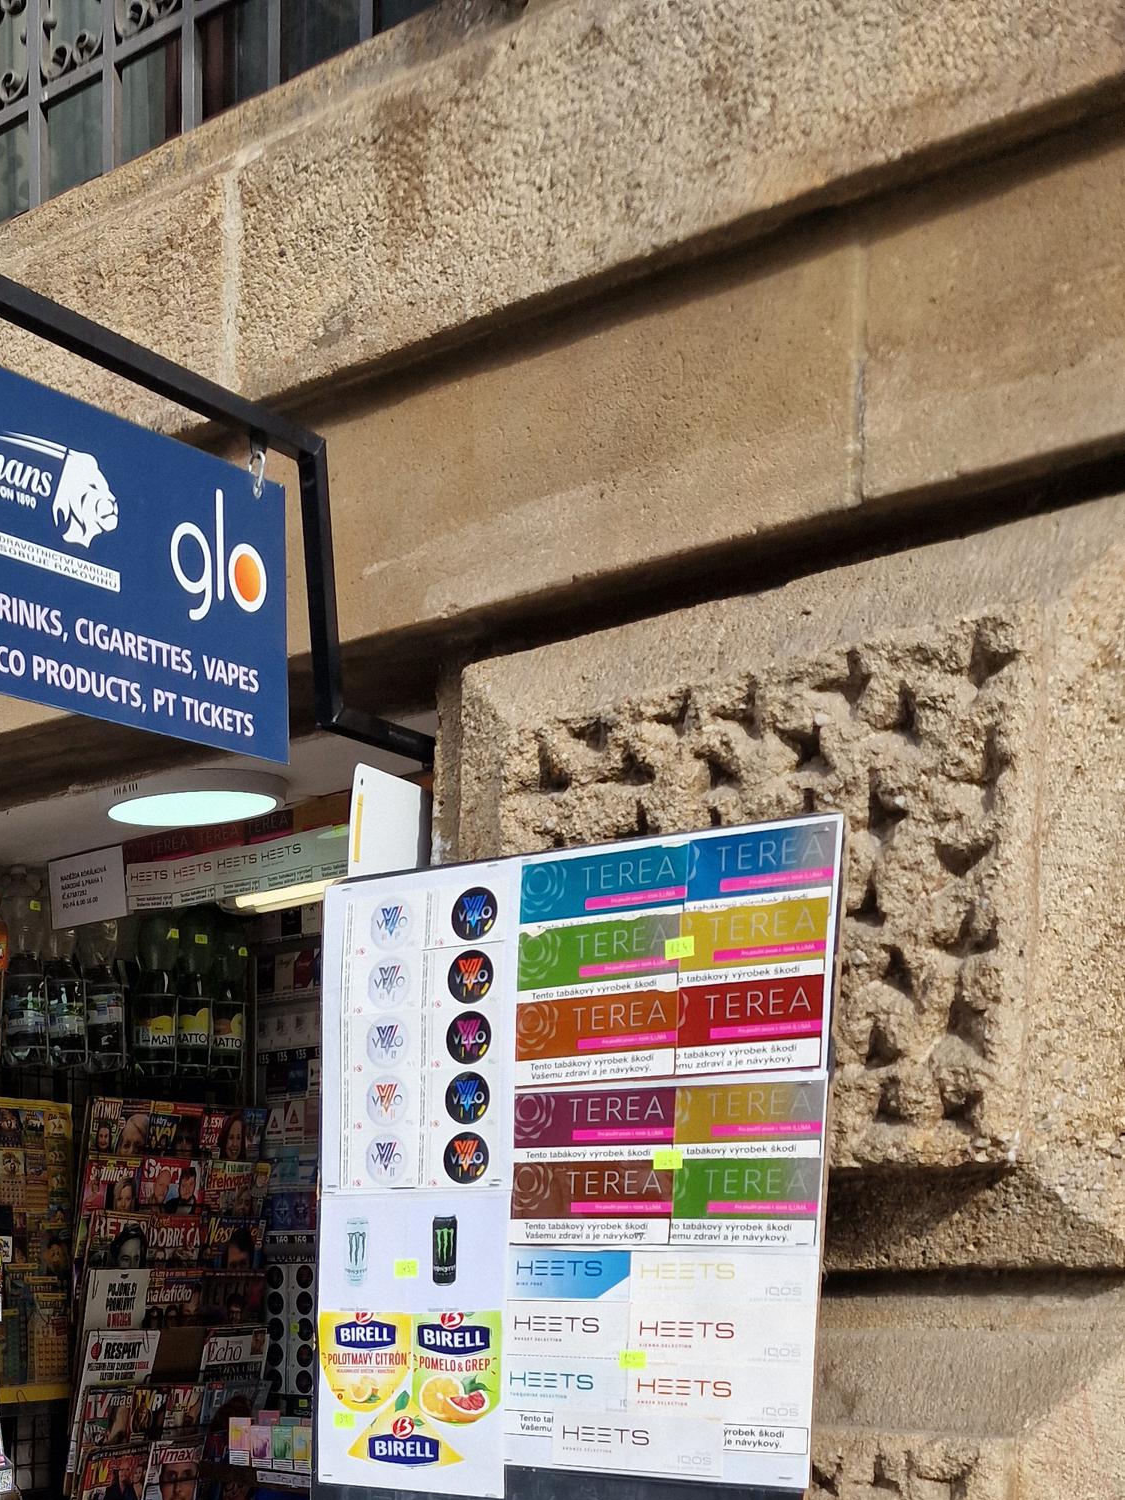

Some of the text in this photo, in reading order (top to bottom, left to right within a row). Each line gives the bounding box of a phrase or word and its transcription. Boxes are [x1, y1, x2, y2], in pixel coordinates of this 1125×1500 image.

[16, 490, 37, 510] 1890
[170, 488, 267, 621] glo
[75, 617, 198, 681] CIGARETTES,
[203, 655, 260, 694] VAPES
[32, 656, 147, 713] PRODUCTS,
[153, 688, 178, 715] PT
[182, 695, 255, 738] TICKETS
[261, 843, 302, 860] HEETS
[717, 834, 825, 872] TEREA
[217, 854, 257, 869] HEETS
[130, 870, 168, 881] HEETS
[582, 856, 675, 891] TEREA
[709, 909, 815, 943] TEREA
[576, 924, 667, 960] TEREA
[687, 965, 800, 984] tabákový výrobek škodí
[704, 986, 812, 1020] TEREA
[572, 1000, 667, 1032] TEREA
[530, 1053, 654, 1071] Tento tabákový výrobek škodí
[531, 1070, 563, 1080] Vašemu
[565, 1067, 590, 1077] zdraví
[599, 1067, 607, 1077] je
[569, 1095, 665, 1123] TEREA
[707, 1088, 812, 1118] TEREA
[566, 1169, 663, 1196] TEREA
[704, 1168, 808, 1194] TEREA
[525, 1221, 648, 1232] Tento tabákový výrobek škodí
[525, 1231, 556, 1240] Vašemu
[558, 1231, 583, 1240] zdraví
[592, 1231, 601, 1241] je
[516, 1260, 603, 1277] HEETS
[641, 1263, 736, 1280] HEETS
[765, 1286, 803, 1296] IQOS
[341, 1326, 391, 1342] BIRELL
[514, 1315, 600, 1334] HEETS
[639, 1321, 735, 1339] HEETS
[424, 1330, 484, 1348] BIRELL
[104, 1342, 142, 1360] RESPEKT
[328, 1349, 408, 1366] POLOTMAVÝ CITRÓN
[419, 1356, 491, 1372] POMELO & GREP
[509, 1371, 594, 1390] HEETS
[637, 1378, 732, 1398] HEETS
[563, 1426, 649, 1446] HEETS
[724, 1427, 784, 1438] ýrobek škodí
[375, 1441, 434, 1458] BIRELL
